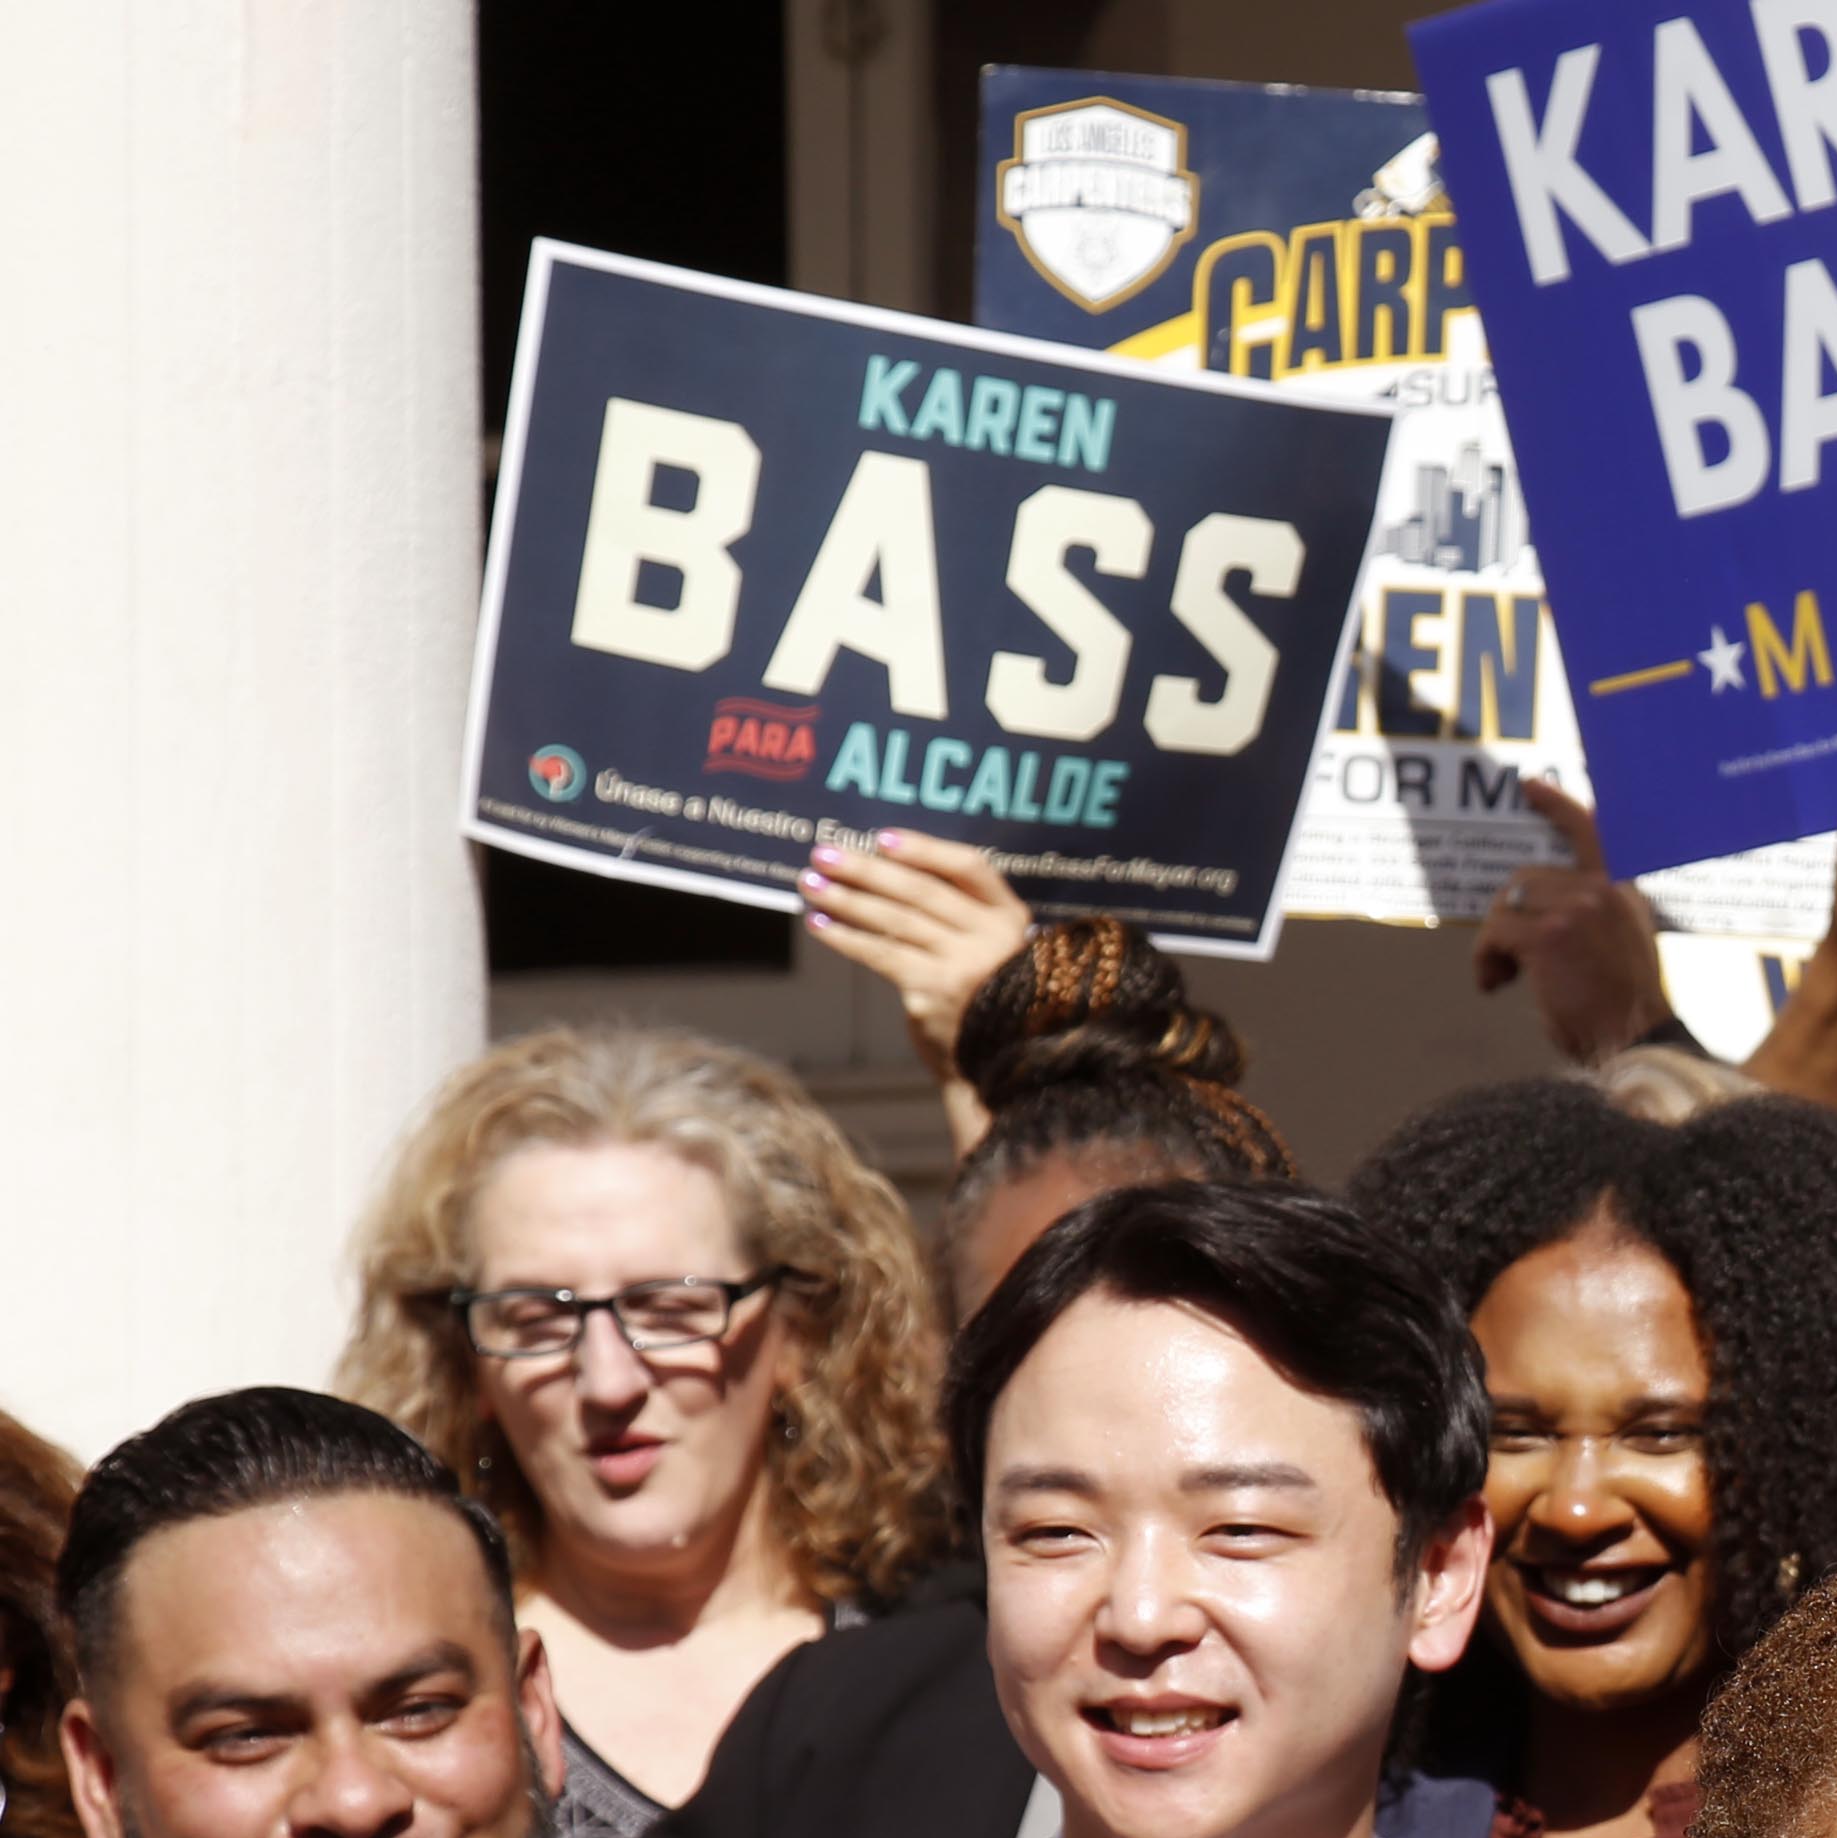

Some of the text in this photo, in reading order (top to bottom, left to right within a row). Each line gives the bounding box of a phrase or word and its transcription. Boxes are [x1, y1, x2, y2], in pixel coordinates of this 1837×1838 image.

[858, 354, 1116, 472] KAREN
[569, 395, 1308, 757] BASS
[706, 714, 1128, 828] PARA ALCALDE
